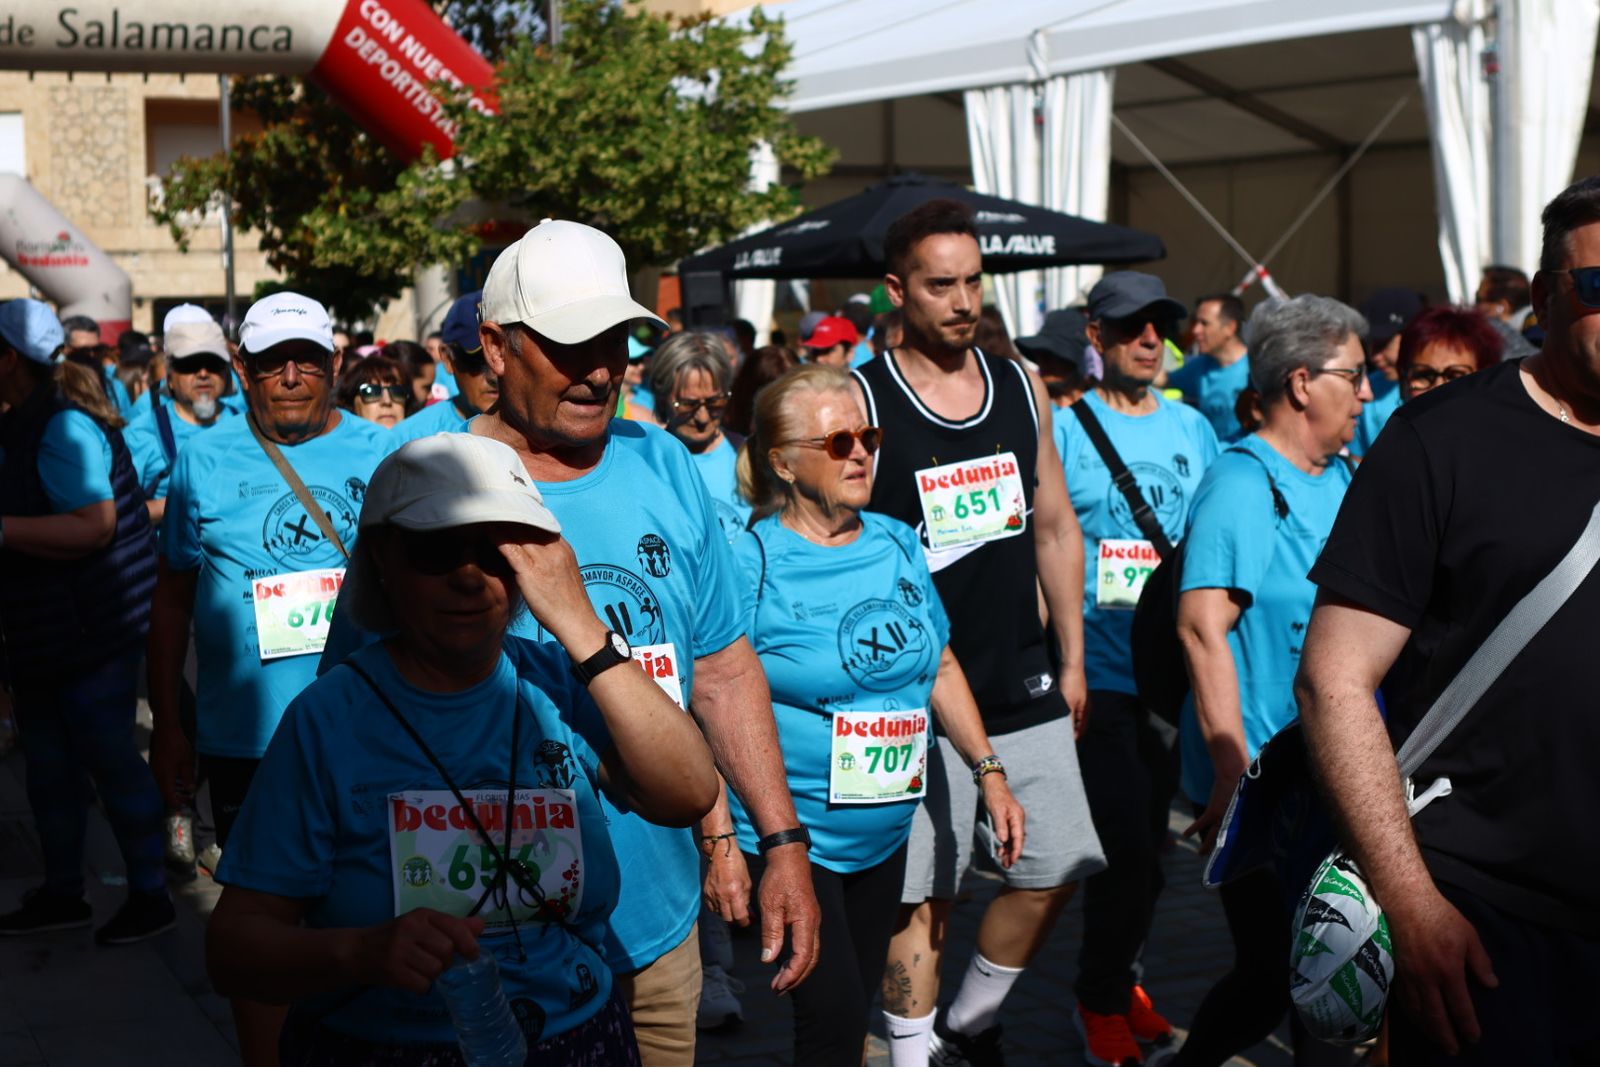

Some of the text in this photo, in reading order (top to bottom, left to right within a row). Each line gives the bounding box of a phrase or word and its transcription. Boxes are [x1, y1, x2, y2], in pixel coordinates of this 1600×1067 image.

[56, 7, 294, 53] Salamanca
[360, 0, 405, 44] CON
[919, 460, 1016, 494] bedunia
[953, 487, 1000, 519] 651
[1101, 544, 1161, 561] bedu
[580, 569, 646, 599] AMAYOR ASPACE
[1123, 566, 1154, 588] 97
[836, 714, 926, 738] bedunia
[864, 743, 913, 774] 707
[393, 796, 575, 833] bedunia
[447, 844, 542, 891] 656
